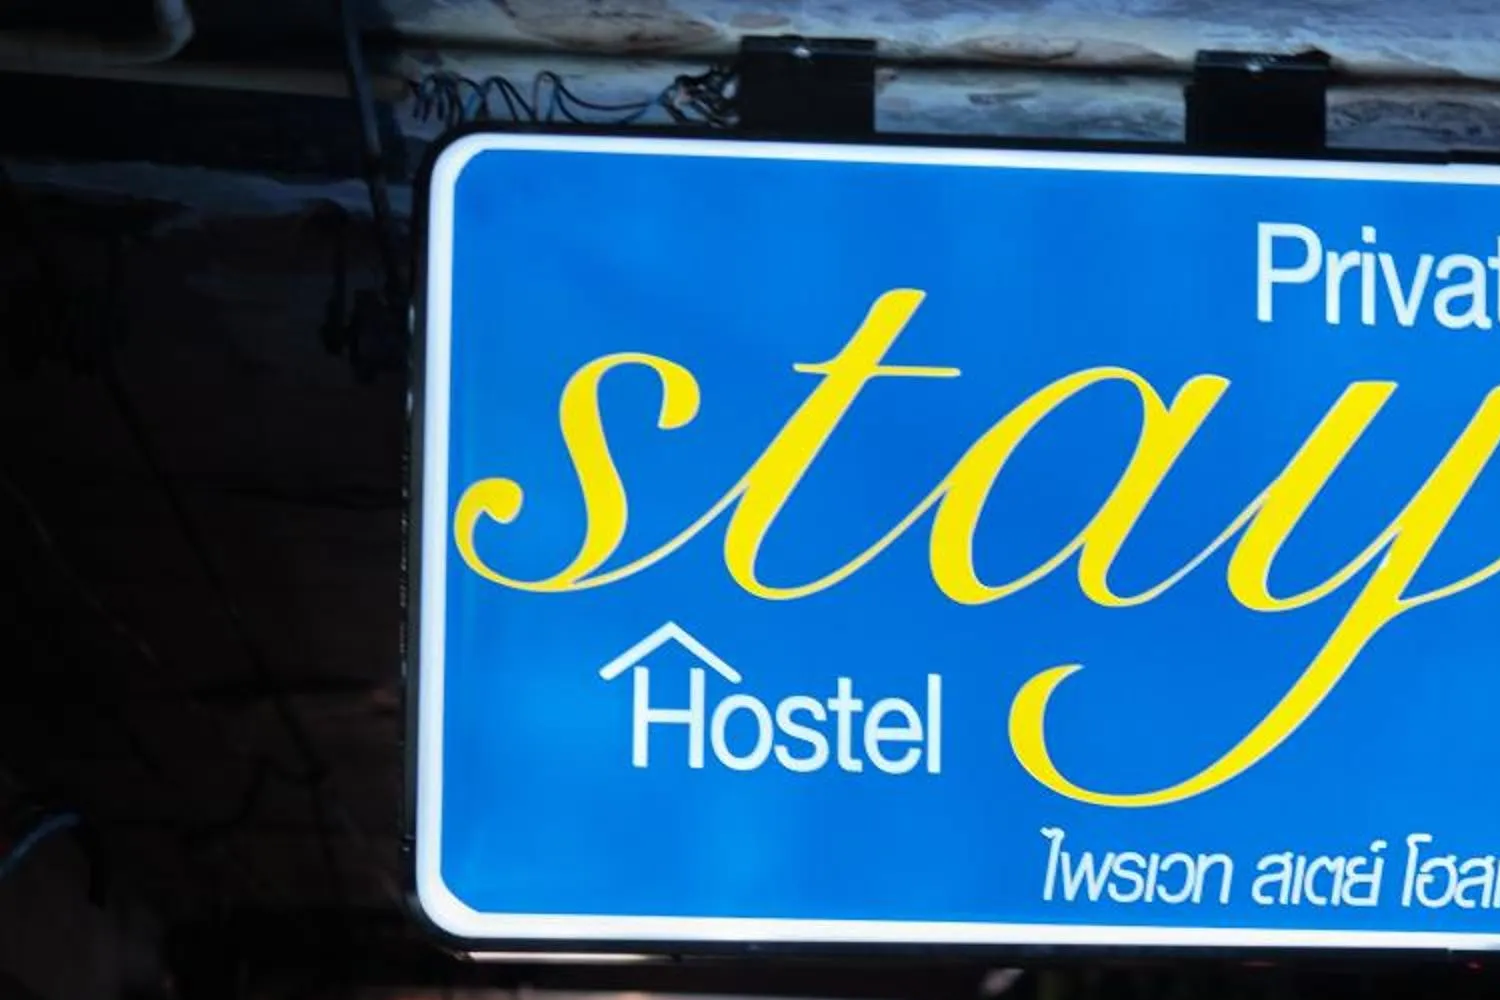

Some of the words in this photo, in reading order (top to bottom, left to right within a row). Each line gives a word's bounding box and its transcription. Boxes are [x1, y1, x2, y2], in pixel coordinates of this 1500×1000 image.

[631, 664, 943, 775] Hostel
[1039, 826, 1235, 905] ไพรเวท
[1250, 838, 1388, 907] สเตย์
